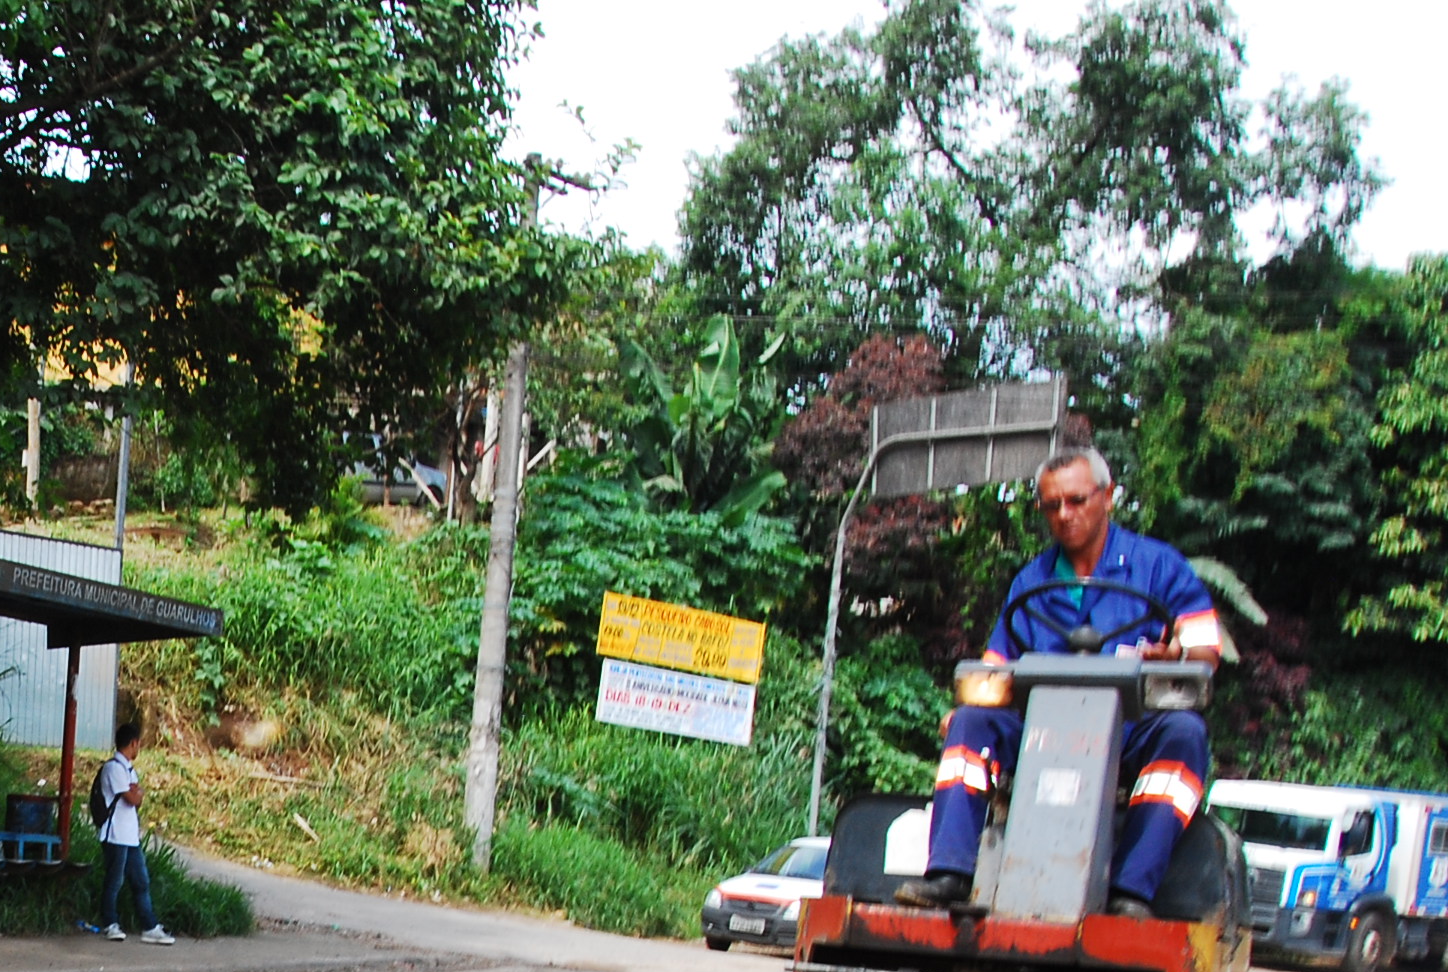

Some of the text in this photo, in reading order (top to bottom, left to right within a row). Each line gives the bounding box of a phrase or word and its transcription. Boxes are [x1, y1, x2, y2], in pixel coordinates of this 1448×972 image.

[13, 566, 216, 628] PREFEITURA MUNICIPAL DE GUARULHOS
